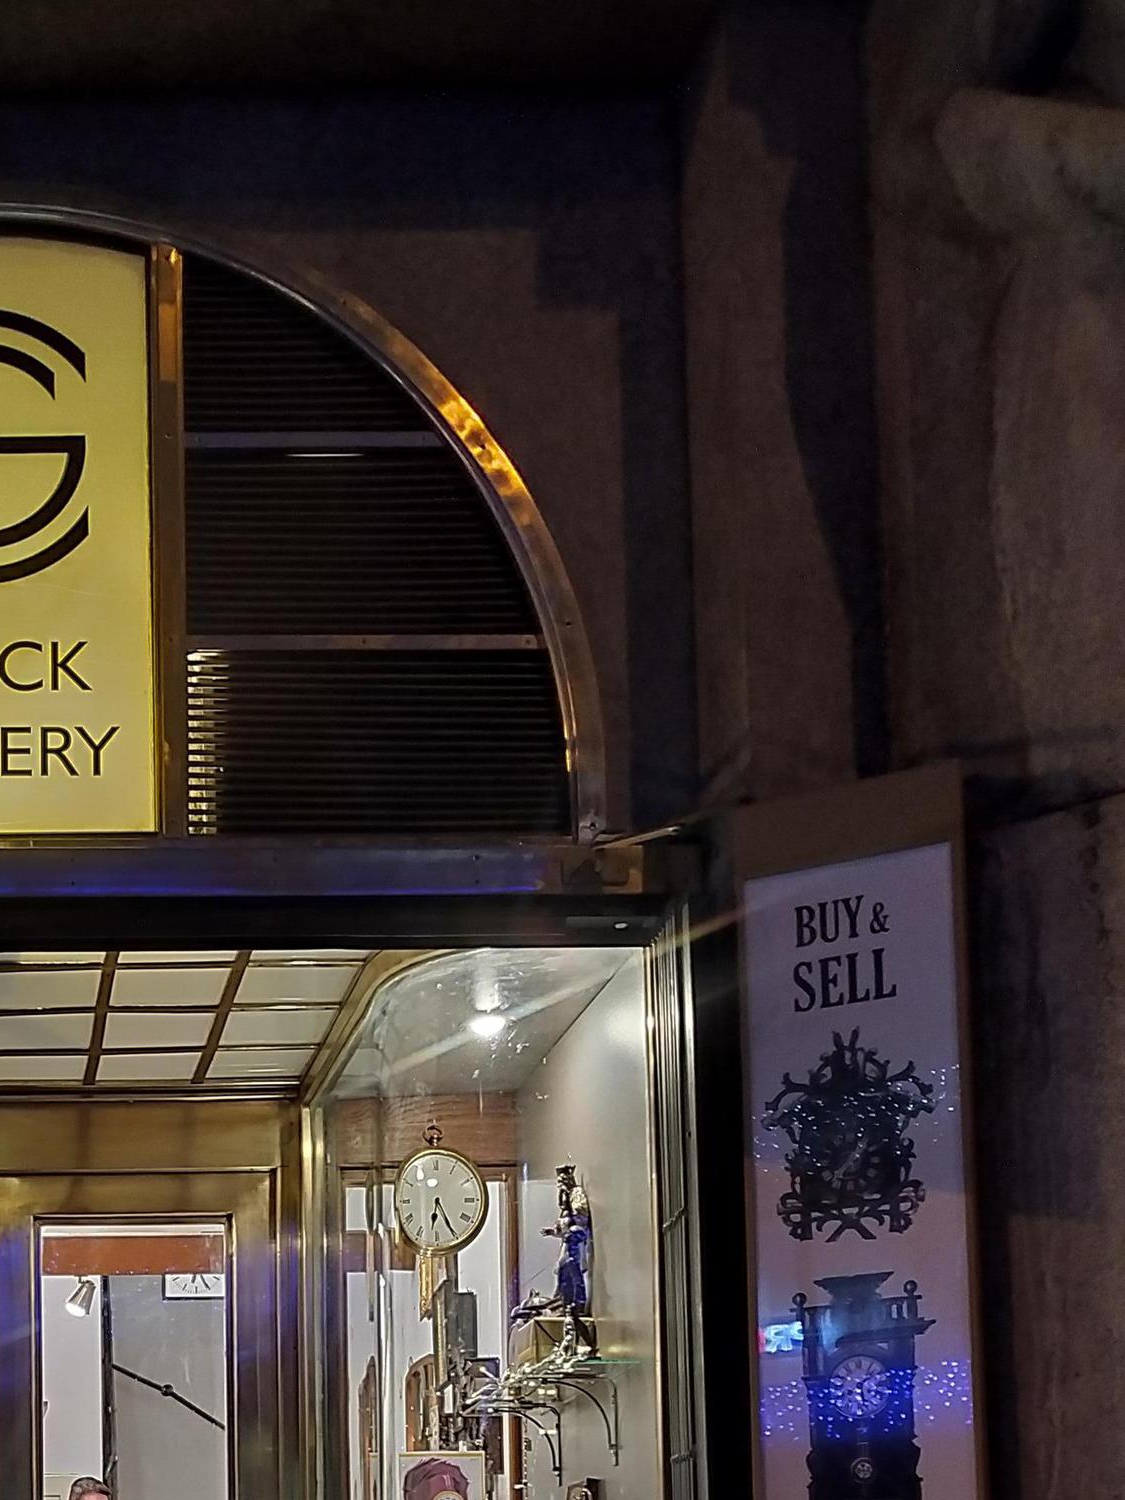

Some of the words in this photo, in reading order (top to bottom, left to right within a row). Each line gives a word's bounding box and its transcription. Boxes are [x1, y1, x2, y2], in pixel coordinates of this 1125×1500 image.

[794, 894, 865, 948] BUY
[869, 902, 891, 934] &
[793, 947, 897, 1013] SELL
